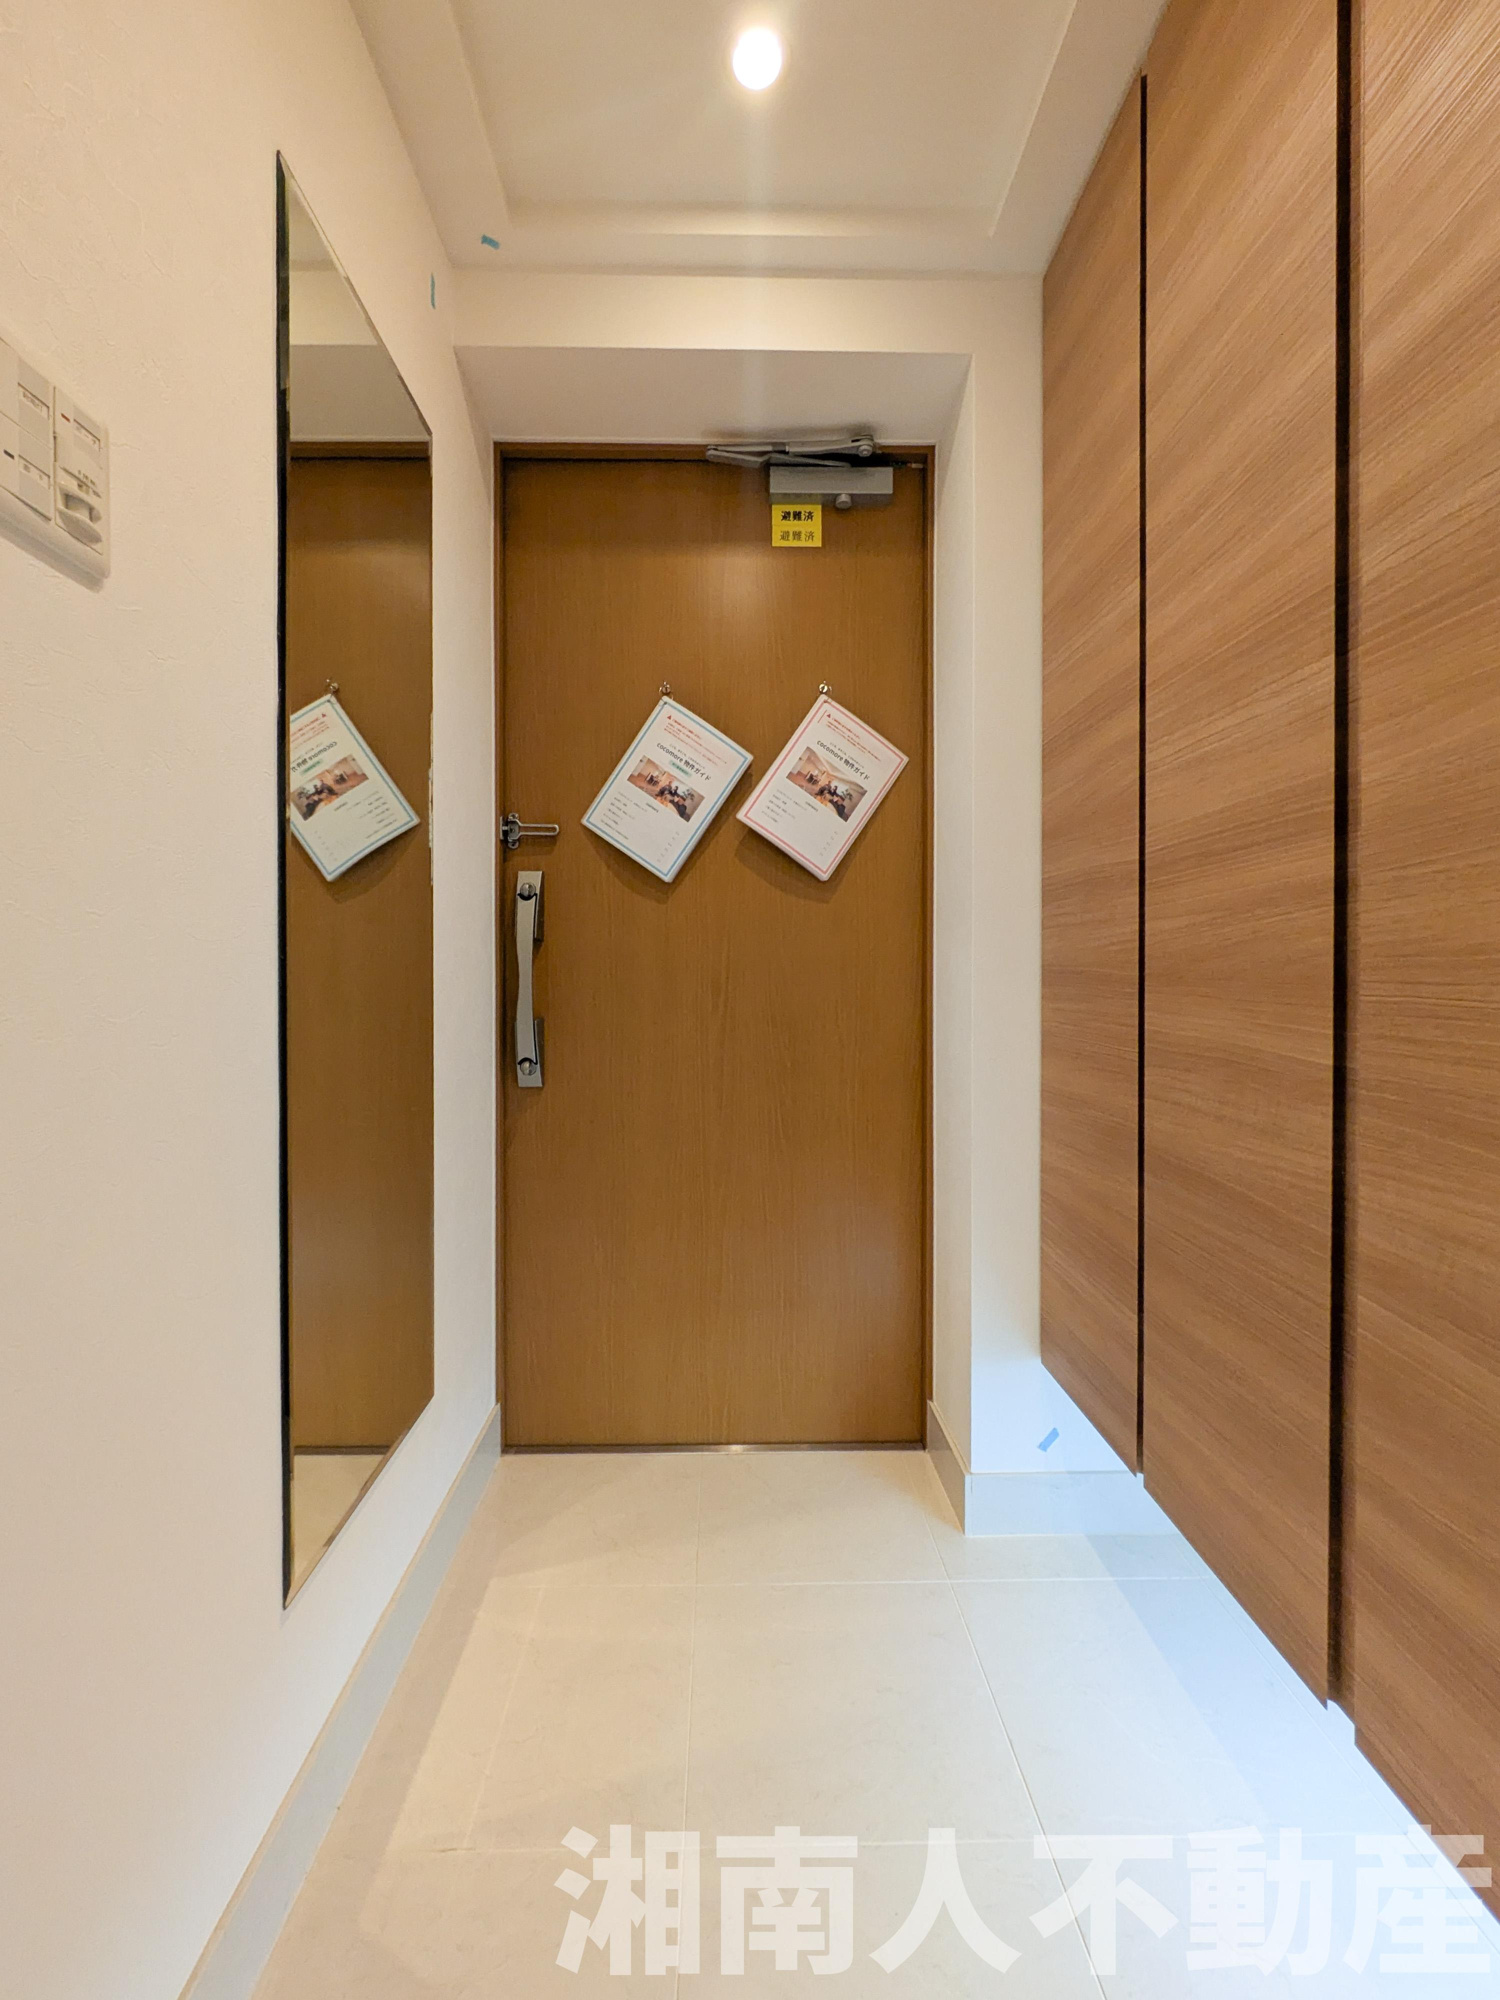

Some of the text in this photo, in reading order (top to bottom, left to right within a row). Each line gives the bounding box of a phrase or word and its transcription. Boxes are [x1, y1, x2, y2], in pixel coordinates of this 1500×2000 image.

[781, 510, 814, 522] 避難済
[780, 530, 814, 542] 避難済
[656, 742, 684, 764] cocomore
[683, 758, 712, 781] 物件ガイド
[817, 740, 844, 762] cocomore
[843, 758, 871, 781] 物件ガイド
